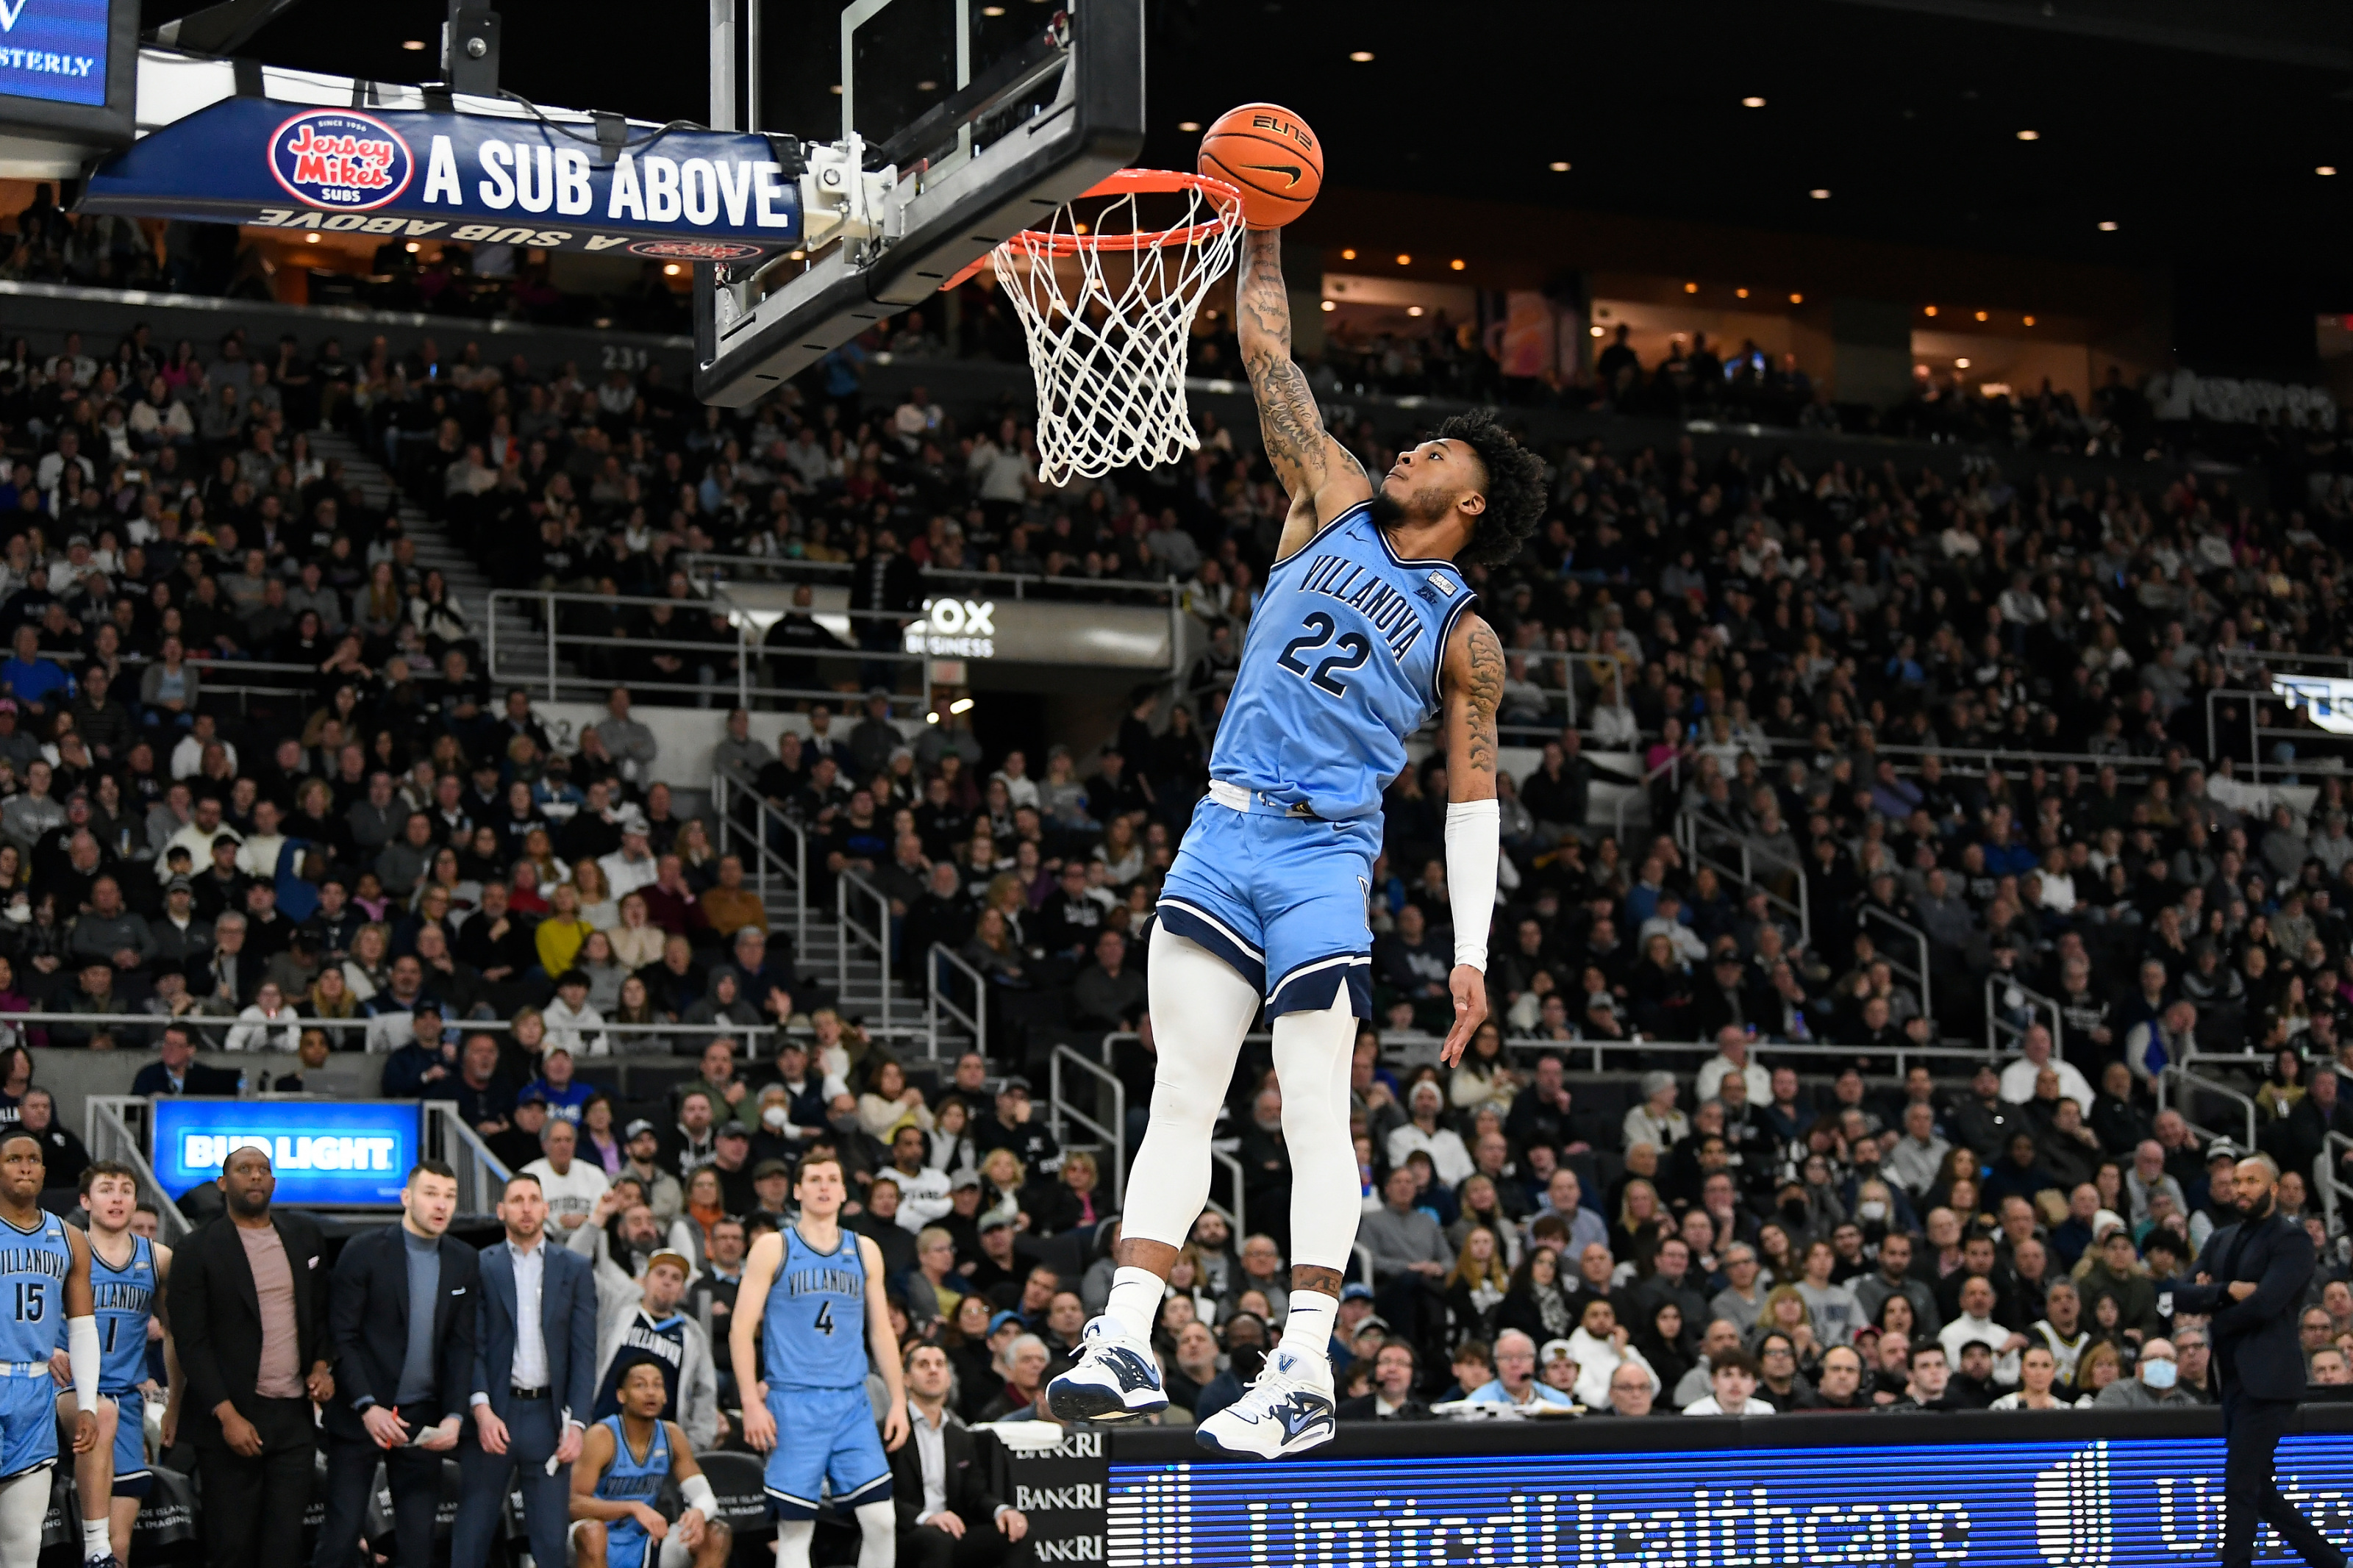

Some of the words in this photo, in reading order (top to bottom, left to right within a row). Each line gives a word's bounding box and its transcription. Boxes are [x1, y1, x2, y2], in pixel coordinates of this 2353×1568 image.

[318, 120, 343, 128] SINCE
[1252, 115, 1313, 152] ELITE
[289, 126, 393, 166] Jersey
[296, 153, 392, 189] Mike's
[423, 135, 463, 205] A
[479, 140, 593, 215] SUB
[608, 154, 788, 227] ABOVE
[321, 188, 361, 202] SUBS
[1298, 555, 1424, 666] VILLANOVA
[905, 634, 995, 658] BUSINESS
[1277, 612, 1371, 699] 22
[276, 1136, 394, 1170] LIGHT
[0, 1247, 65, 1286] ILLANOVA
[15, 1282, 46, 1323] 15
[814, 1300, 834, 1336] 4
[105, 1316, 118, 1354] 1
[1015, 1483, 1102, 1511] BANKRI
[1034, 1534, 1102, 1563] ANKRI
